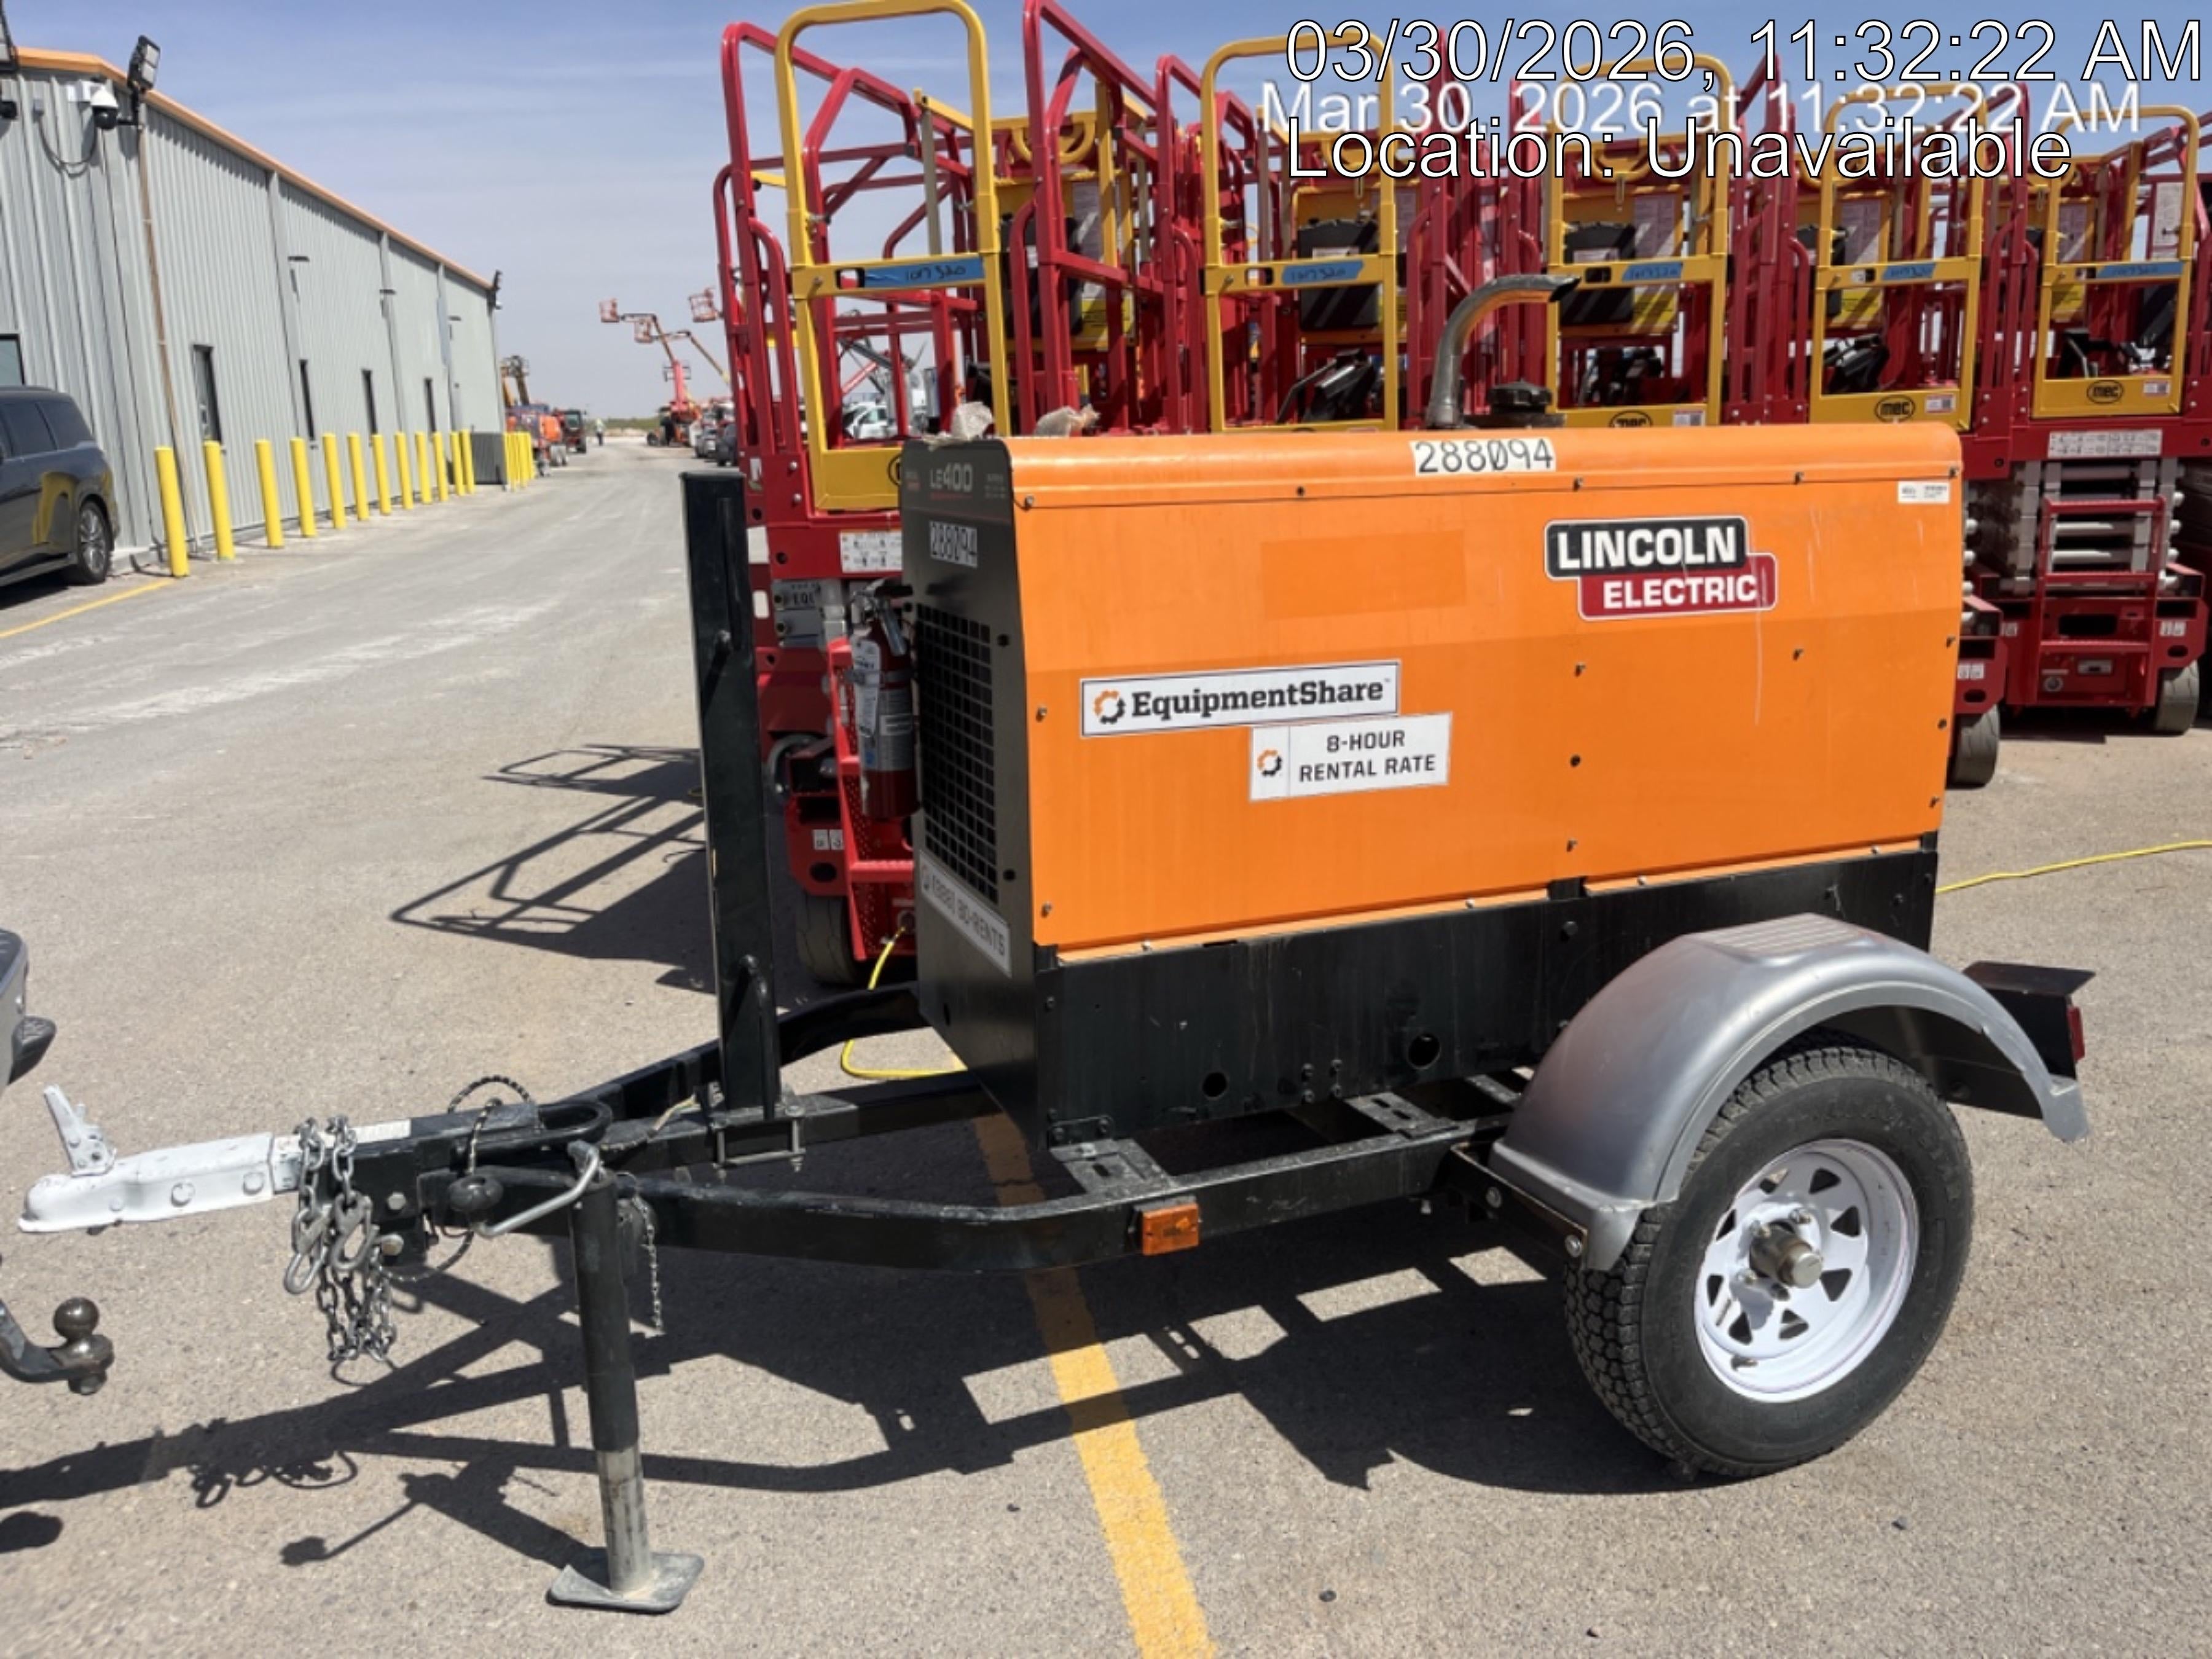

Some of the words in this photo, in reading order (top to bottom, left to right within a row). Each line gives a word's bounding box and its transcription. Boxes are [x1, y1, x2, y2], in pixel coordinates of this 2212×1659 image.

[1415, 437, 1553, 473] 288094
[1557, 525, 1736, 570] LINCOLN
[1603, 575, 1758, 610] ELECTRIC
[1131, 680, 1384, 720] EquipmentShare
[1326, 730, 1406, 753] 8-HOUR
[1299, 759, 1378, 782] RENTAL
[1384, 754, 1437, 775] RATE
